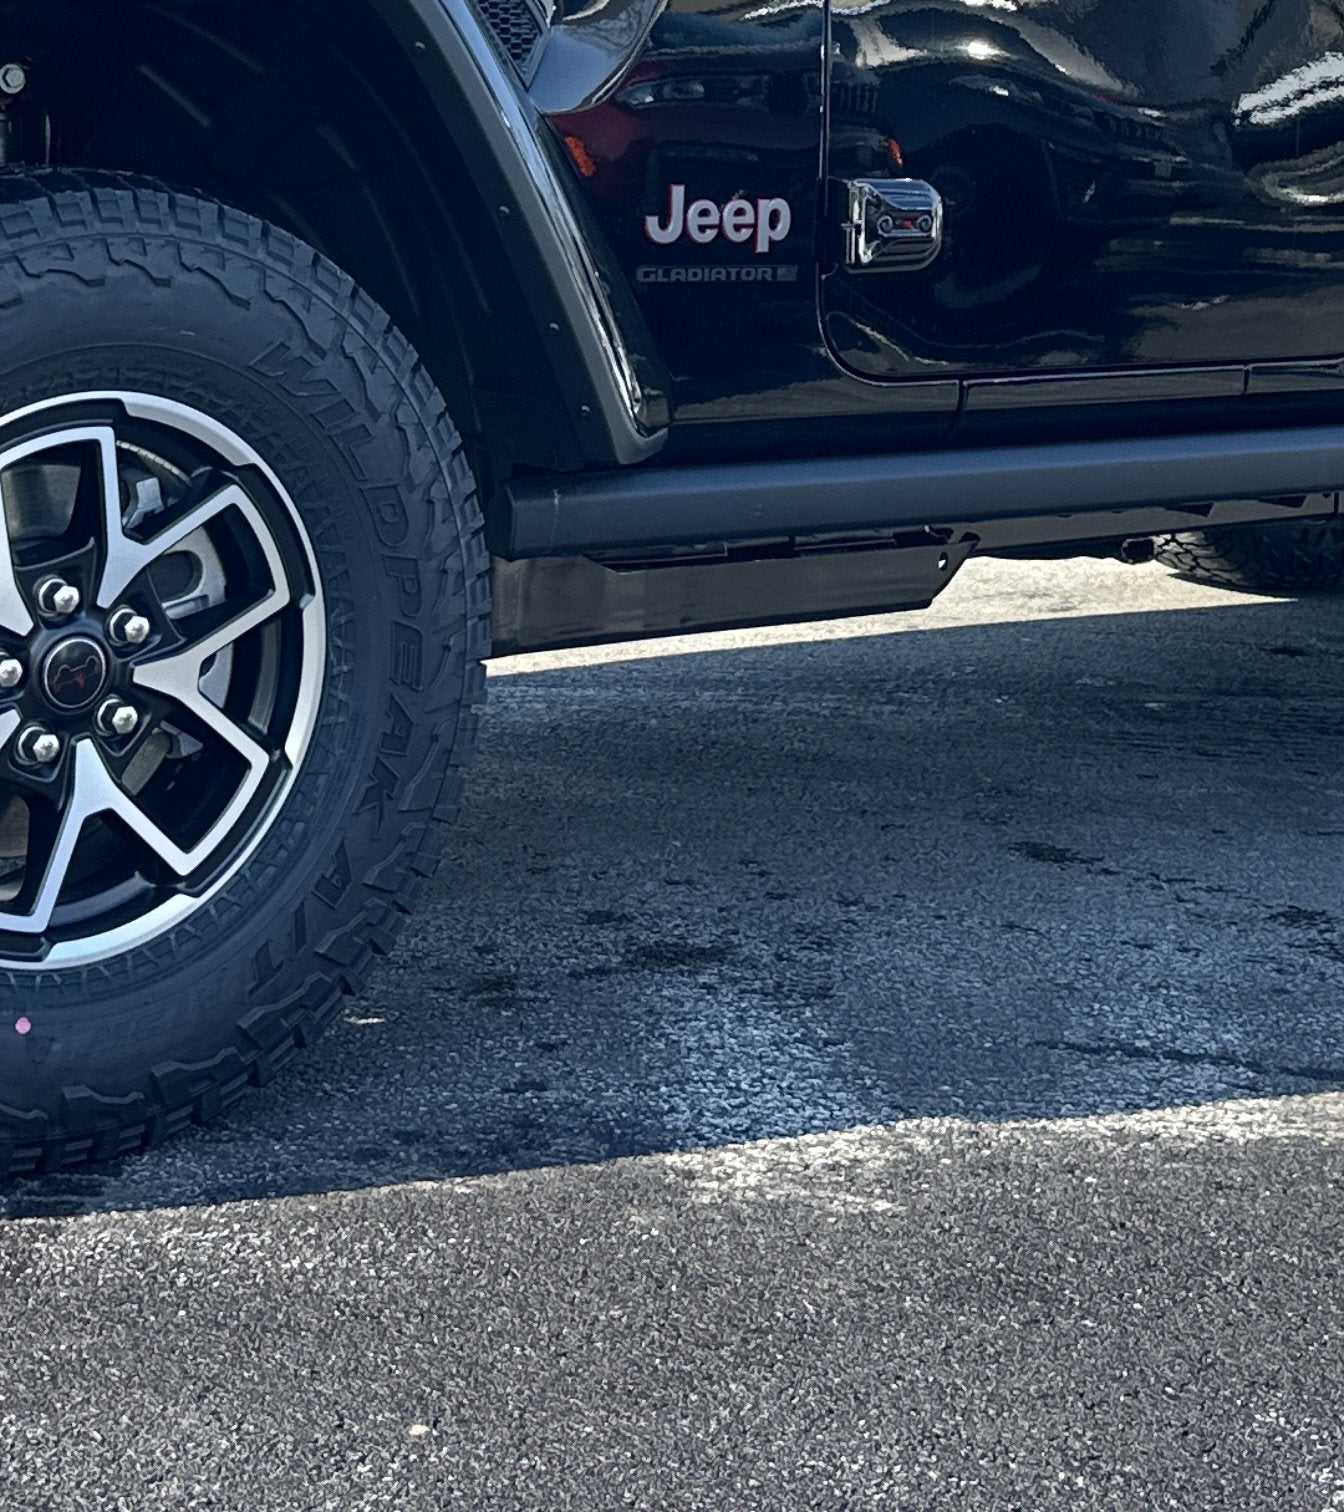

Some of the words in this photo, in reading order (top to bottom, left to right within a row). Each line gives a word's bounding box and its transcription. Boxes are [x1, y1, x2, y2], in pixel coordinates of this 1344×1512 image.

[643, 183, 792, 254] Jeep
[636, 265, 774, 283] GLADIATOR
[248, 341, 426, 834] WILDPEAK
